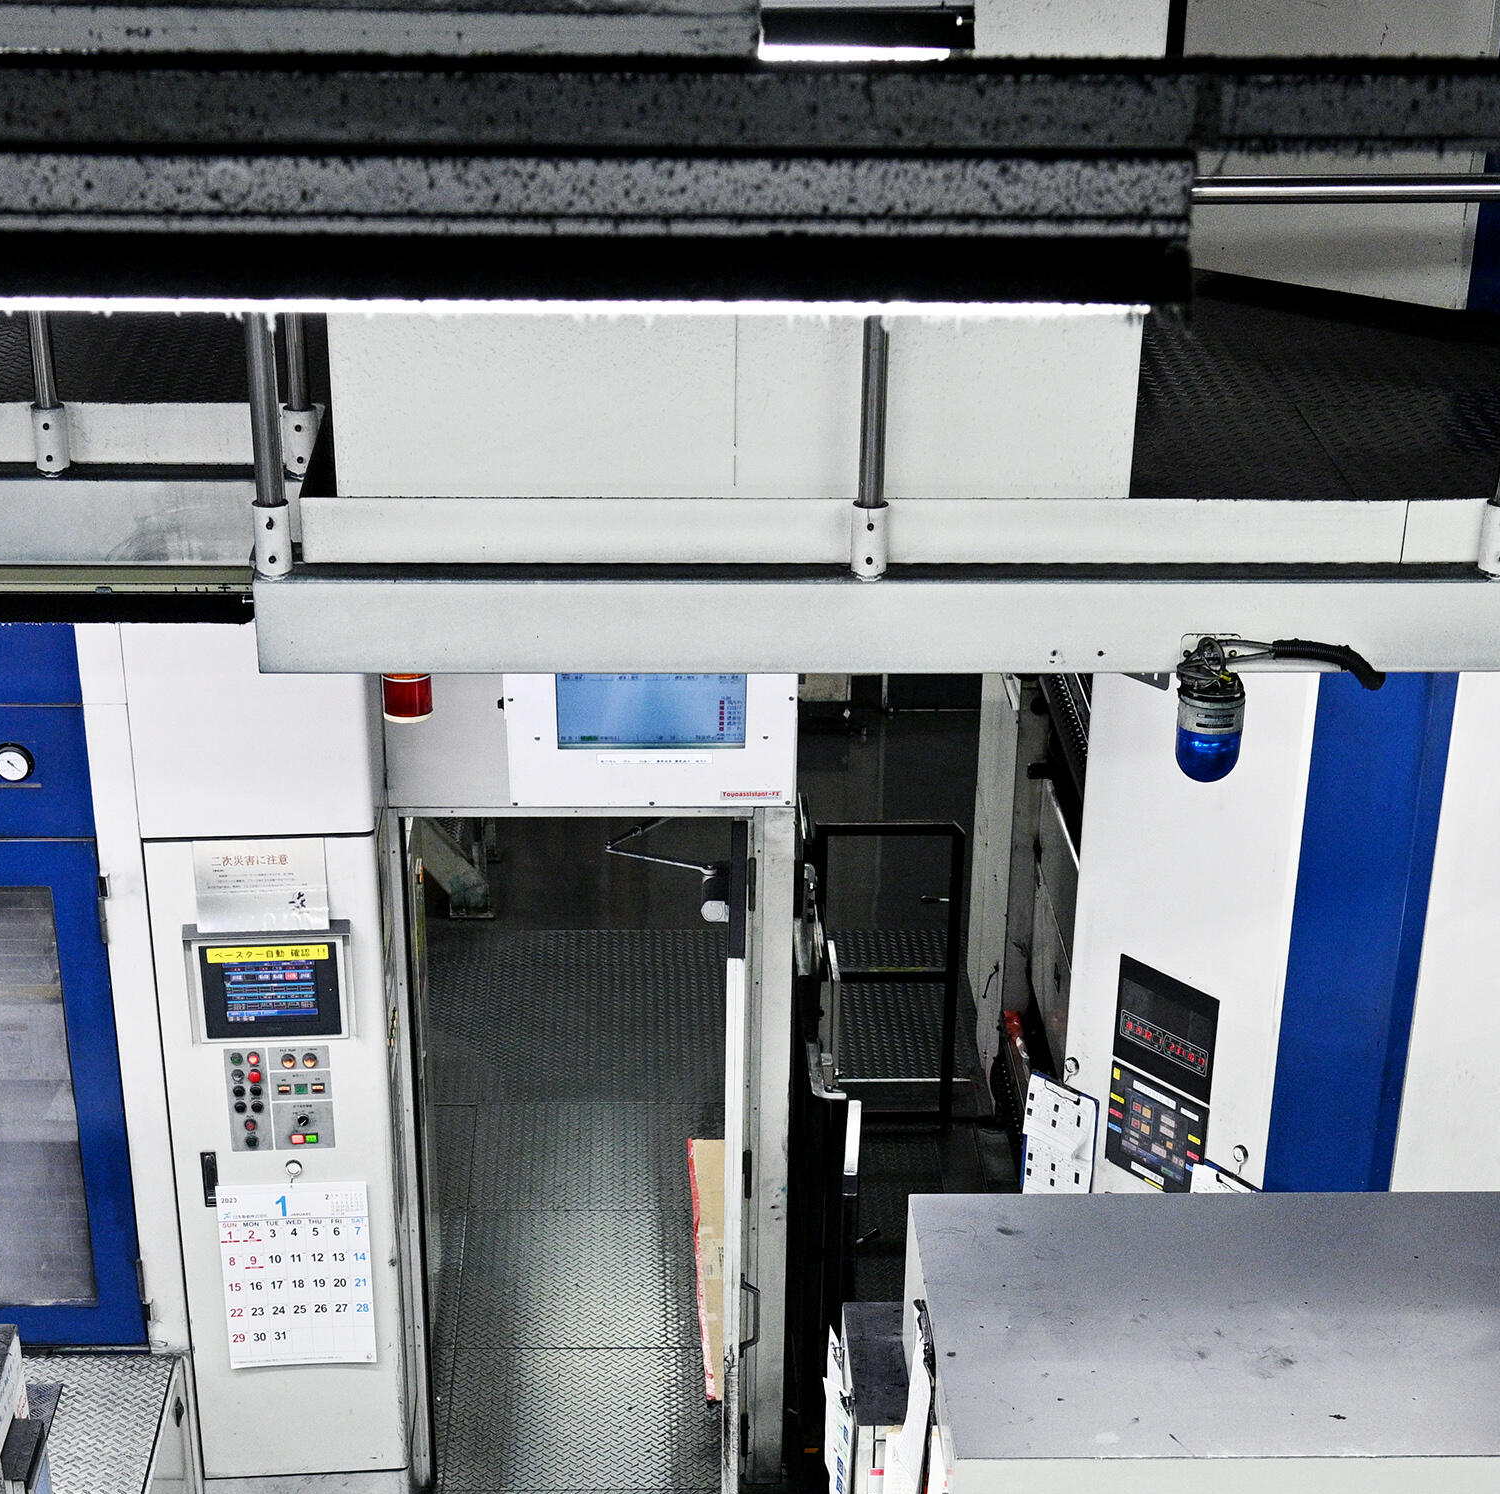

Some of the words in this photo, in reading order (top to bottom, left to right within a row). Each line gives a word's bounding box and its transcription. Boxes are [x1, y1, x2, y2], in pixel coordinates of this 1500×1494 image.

[211, 854, 289, 866] 二次災害に注意
[290, 948, 311, 957] 確認
[275, 1195, 287, 1217] 1
[227, 1231, 233, 1240] 1
[248, 1230, 255, 1239] 2
[269, 1229, 277, 1238] 3
[290, 1227, 298, 1237] 4
[312, 1227, 319, 1237] 5
[333, 1226, 341, 1236] 6
[355, 1226, 362, 1235] 7
[228, 1257, 236, 1266] 8
[250, 1255, 257, 1265] 9
[269, 1254, 282, 1264] 10
[290, 1254, 302, 1263] 11
[311, 1253, 324, 1262] 12
[332, 1252, 345, 1262] 13
[353, 1252, 366, 1261] 14
[228, 1282, 242, 1292] 15
[250, 1281, 263, 1291] 16
[270, 1280, 283, 1290] 17
[291, 1279, 305, 1289] 18
[312, 1278, 326, 1288] 19
[333, 1278, 347, 1288] 20
[354, 1278, 367, 1287] 21
[230, 1308, 244, 1318] 22
[251, 1307, 265, 1317] 23
[272, 1306, 286, 1316] 24
[293, 1305, 307, 1315] 25
[314, 1304, 328, 1314] 26
[335, 1303, 348, 1313] 27
[356, 1303, 369, 1313] 28
[232, 1333, 246, 1343] 29
[253, 1332, 267, 1342] 30
[274, 1331, 287, 1341] 31
